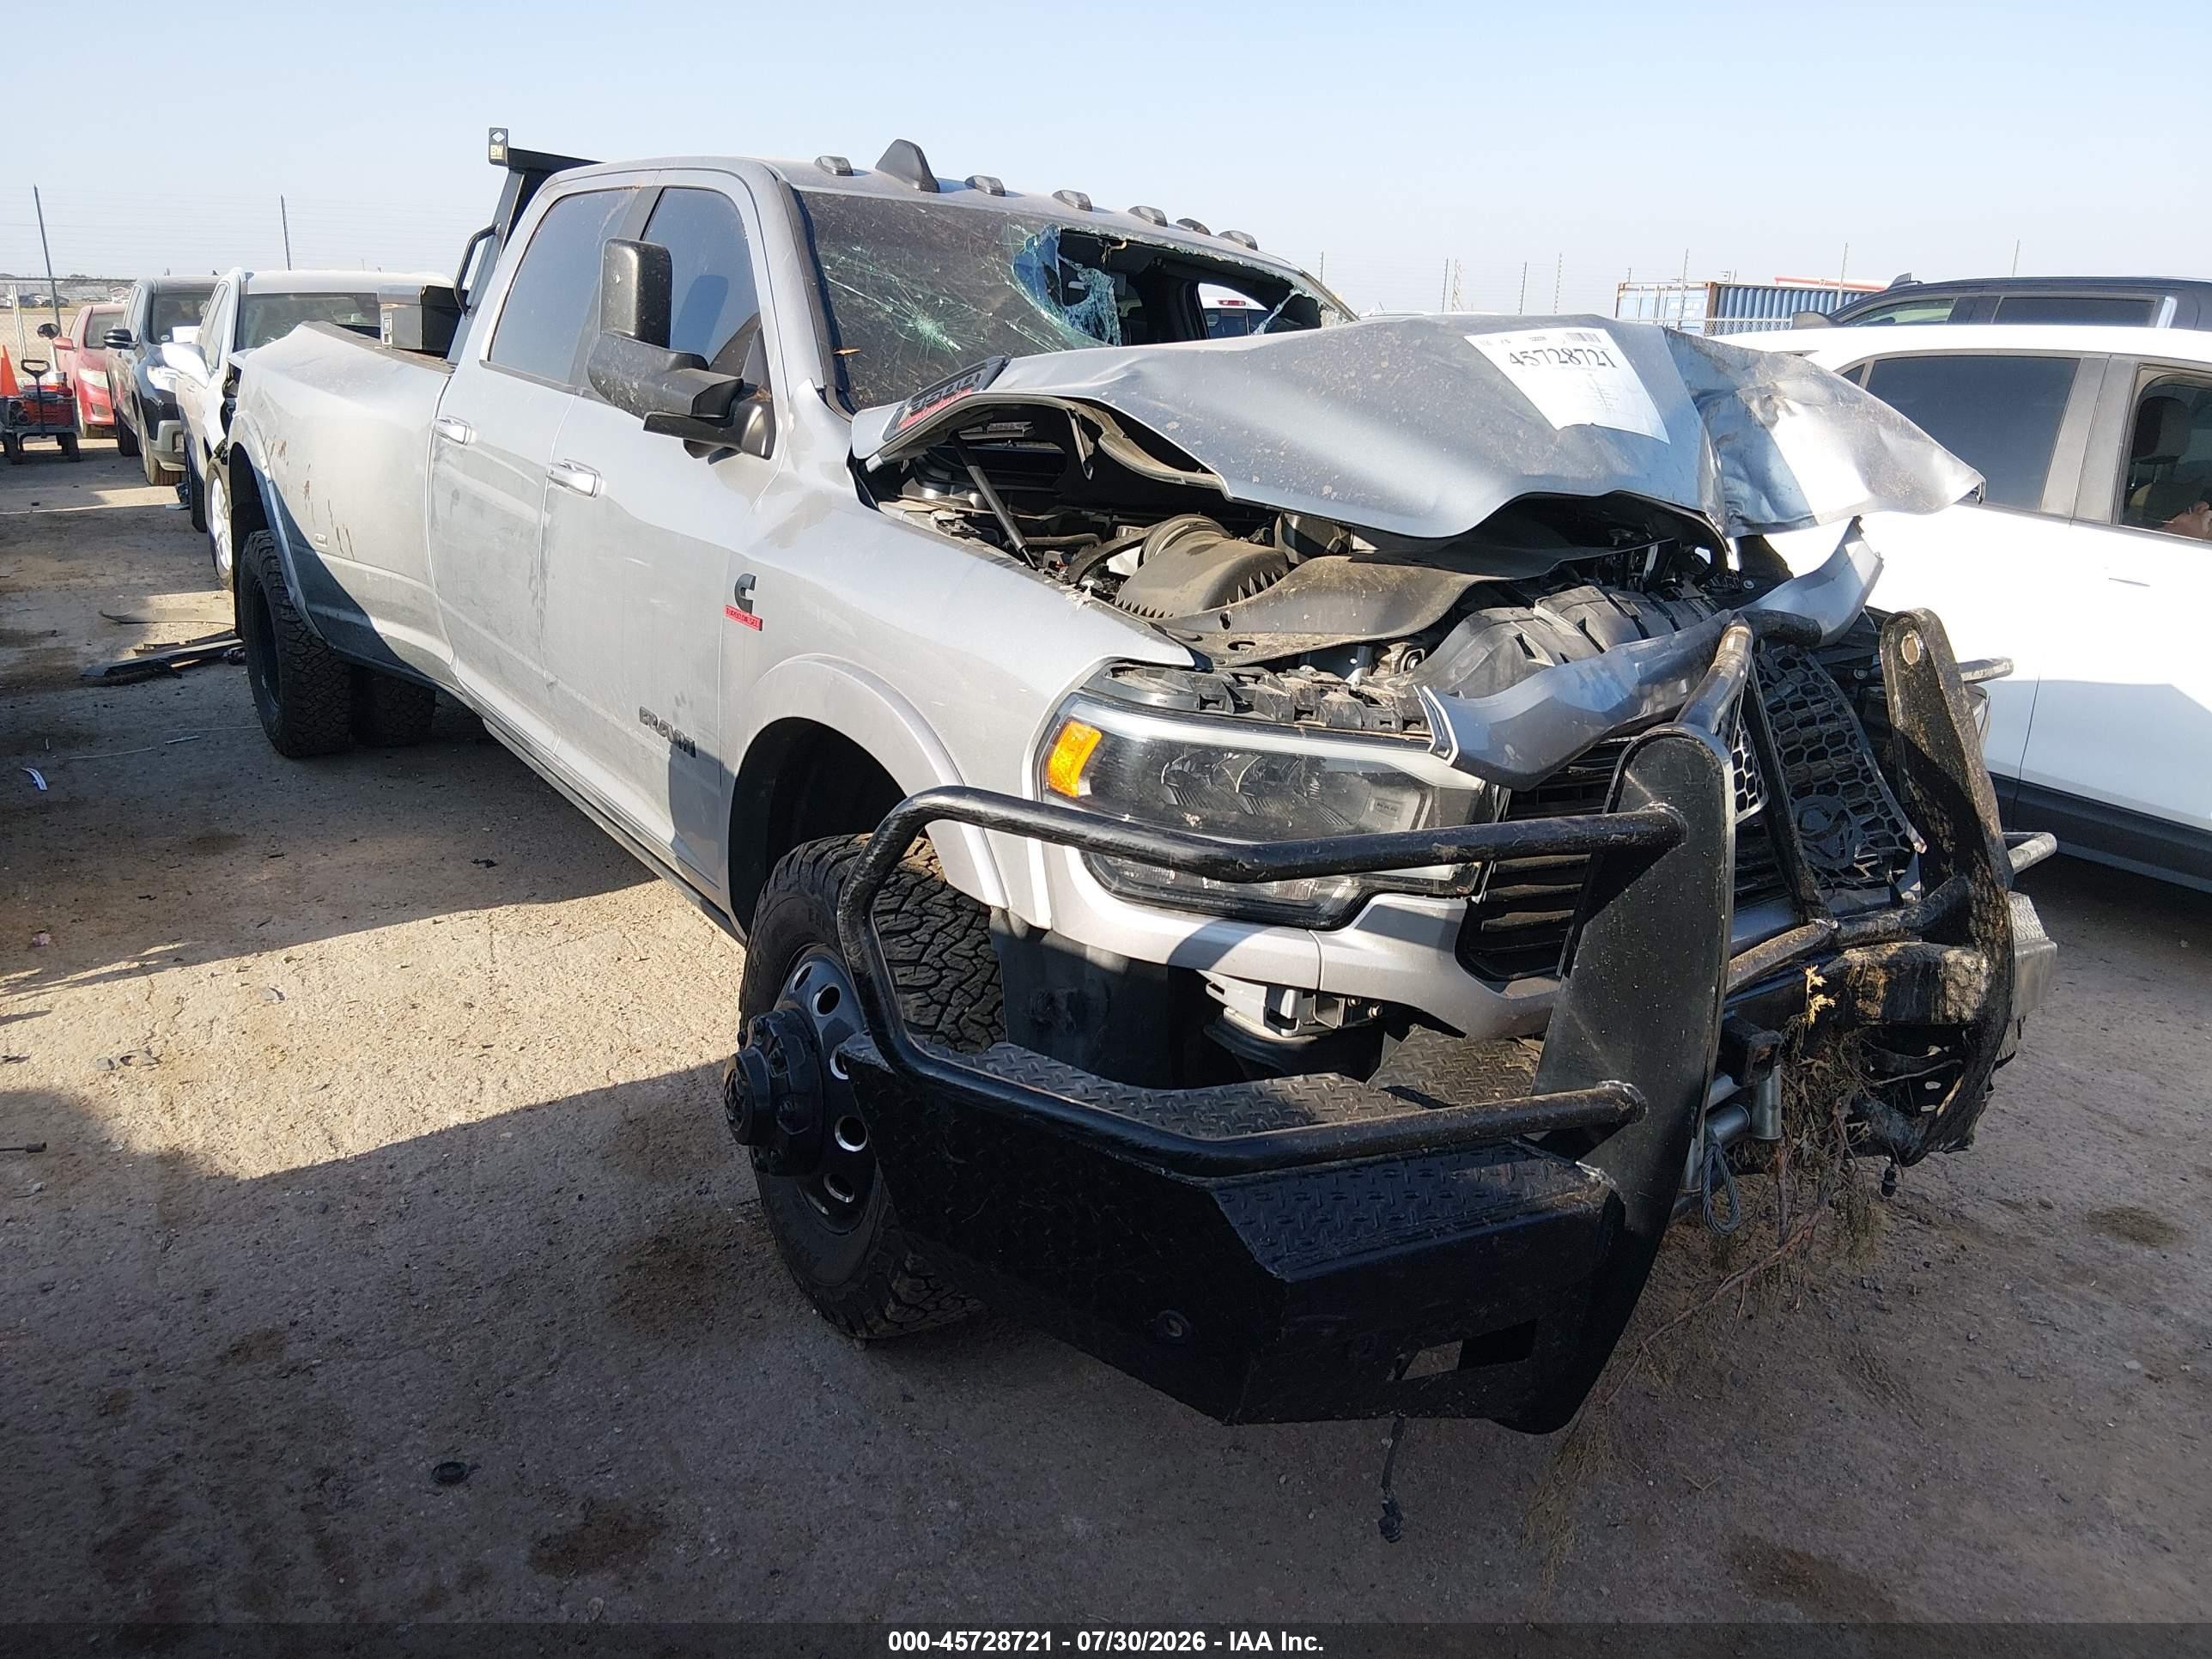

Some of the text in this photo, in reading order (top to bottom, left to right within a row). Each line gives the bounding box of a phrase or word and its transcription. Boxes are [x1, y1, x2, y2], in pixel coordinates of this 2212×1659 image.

[1510, 347, 1617, 368] 45728721
[908, 372, 982, 416] 3500
[639, 705, 696, 758] RAM
